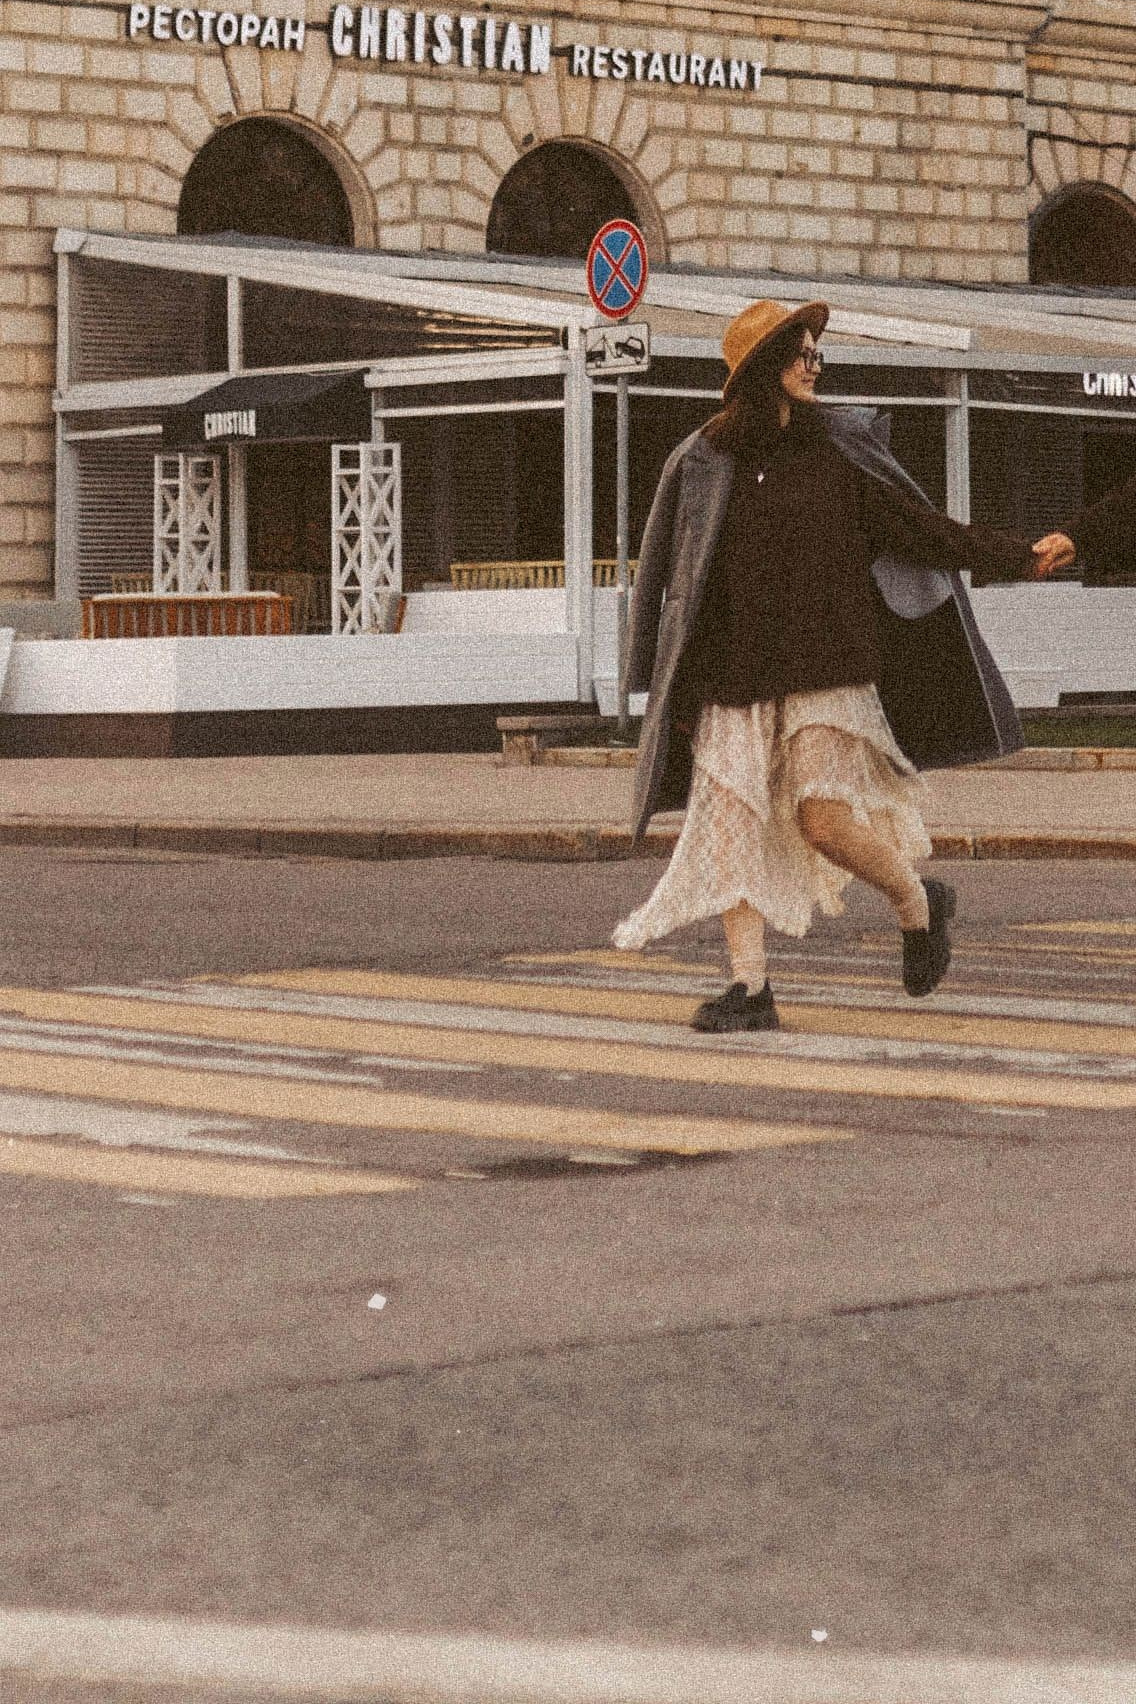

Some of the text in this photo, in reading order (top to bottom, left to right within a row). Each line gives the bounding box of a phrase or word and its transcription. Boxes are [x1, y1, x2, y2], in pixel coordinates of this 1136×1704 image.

[129, 3, 766, 91] РЕСТОРАН CHRISTIAN RESTAURANT
